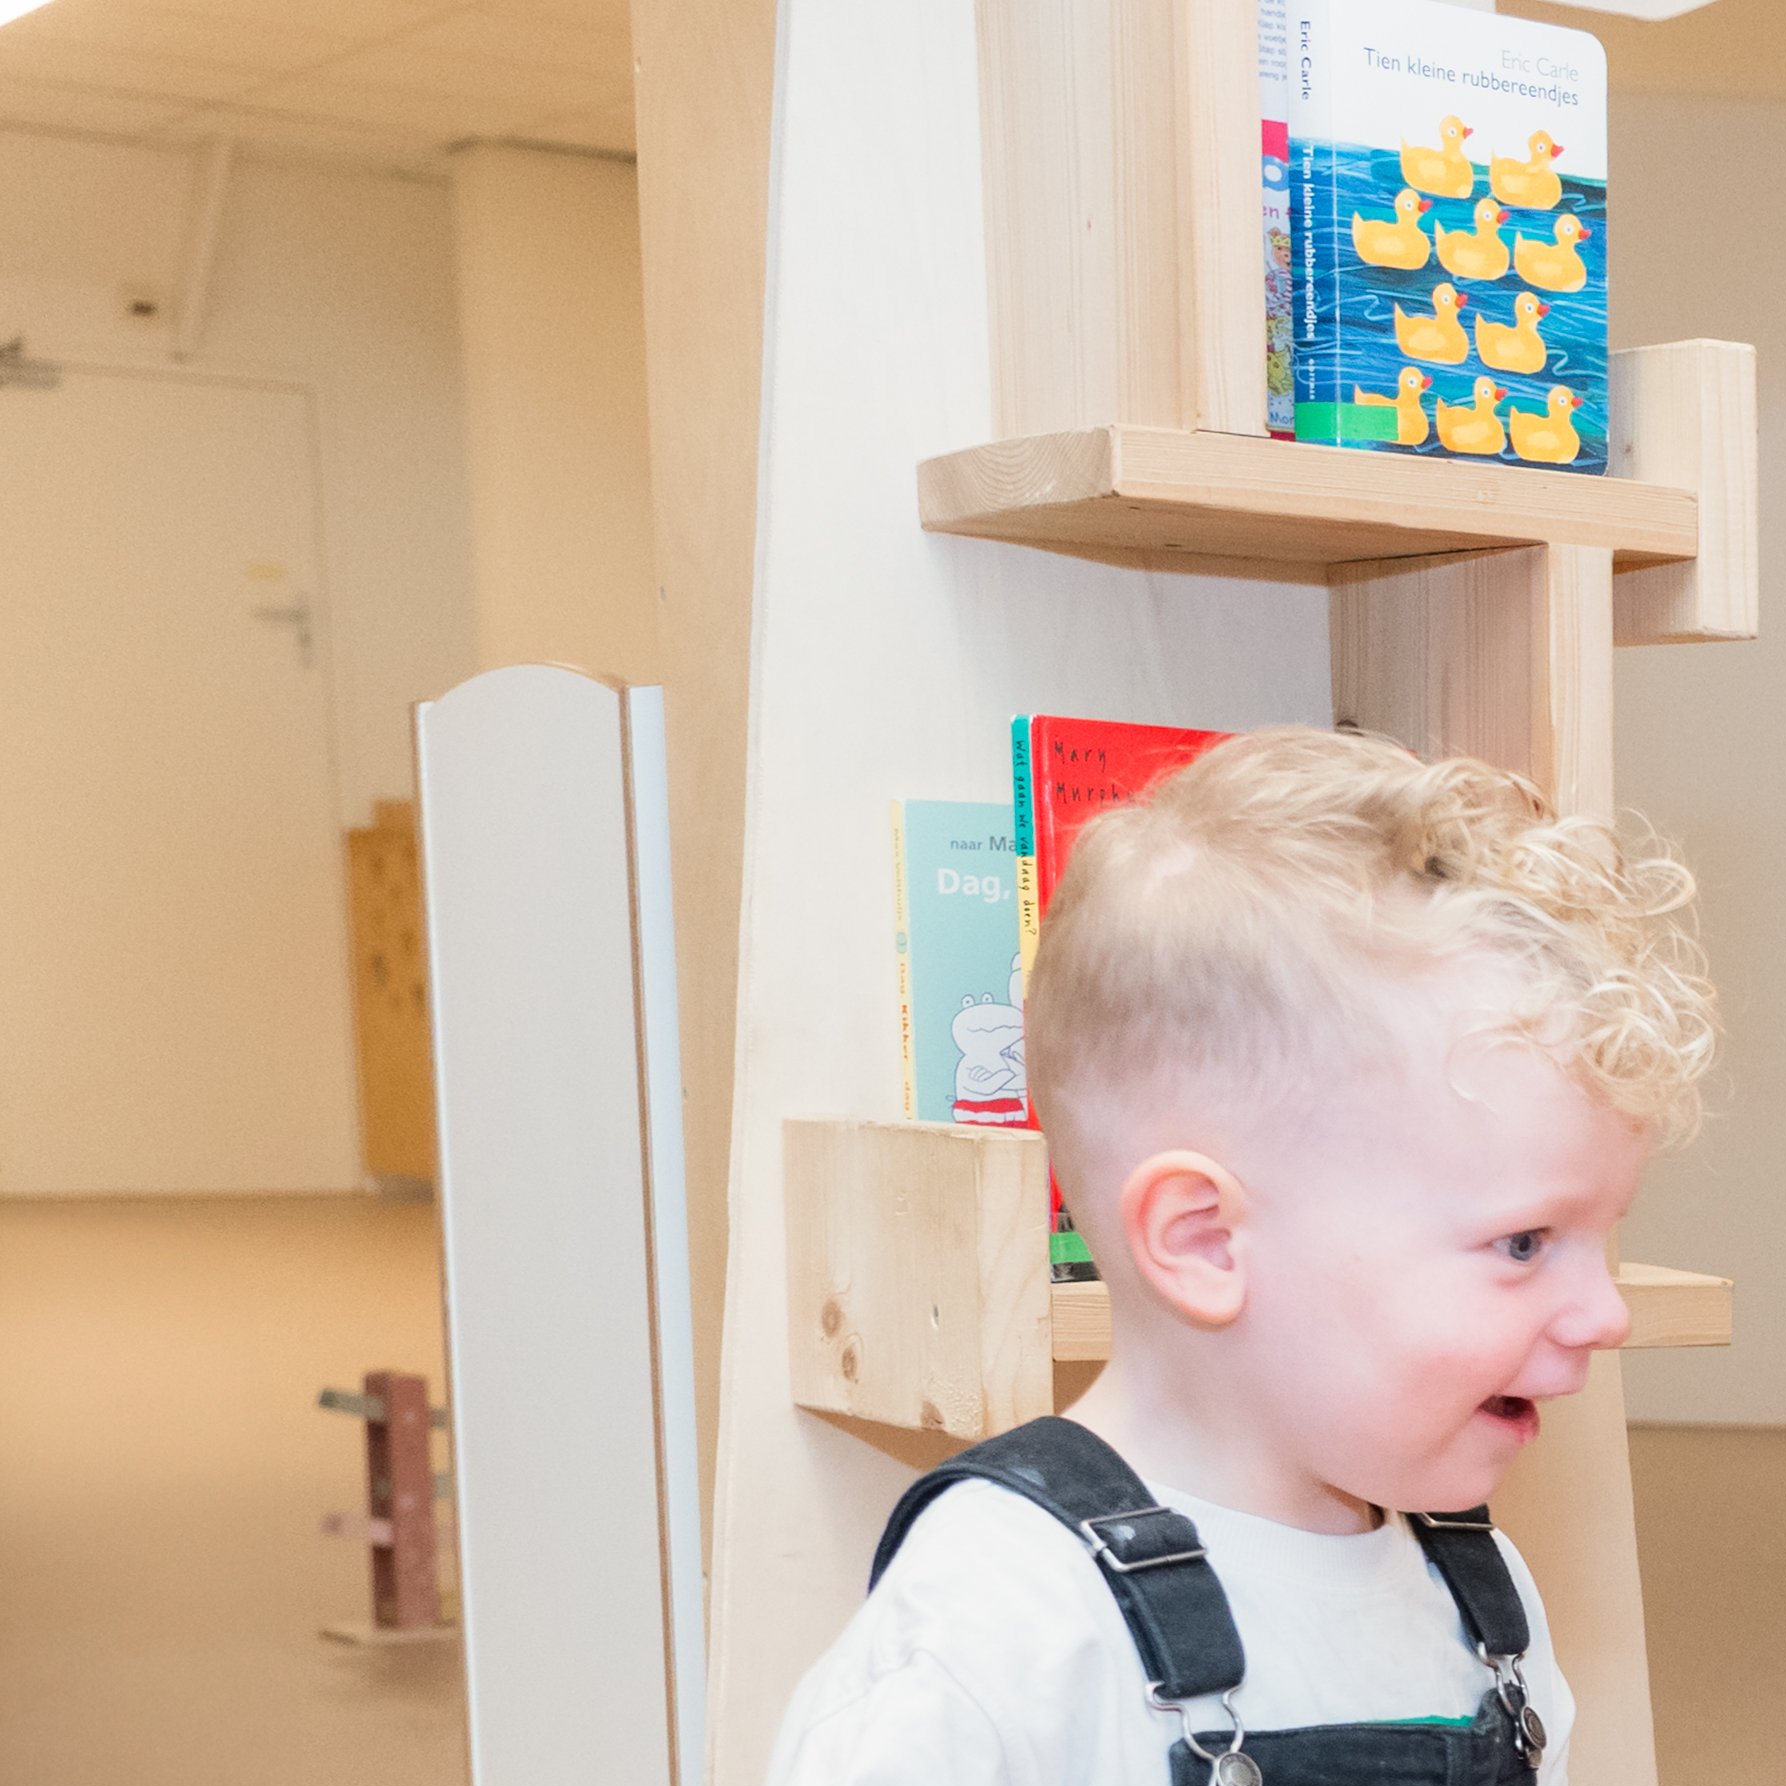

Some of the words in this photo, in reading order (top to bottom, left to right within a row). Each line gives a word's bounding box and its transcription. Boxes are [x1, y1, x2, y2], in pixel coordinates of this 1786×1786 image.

[1300, 20, 1312, 52] Eric
[1301, 56, 1312, 100] Carle
[1364, 47, 1401, 72] Tien
[1407, 56, 1456, 83] kleine
[1462, 71, 1579, 108] rubbereendjes
[1501, 50, 1531, 73] Eric
[1536, 57, 1580, 83] Carle
[1302, 145, 1315, 180] Tien
[1303, 183, 1316, 229] kleine
[1304, 230, 1318, 340] rubbereendjes
[1015, 740, 1028, 767] Wat
[1014, 776, 1026, 808] gaan
[950, 840, 983, 851] naar
[1018, 836, 1033, 891] vandaag
[937, 867, 1011, 903] Dag,
[1023, 900, 1037, 936] doen?
